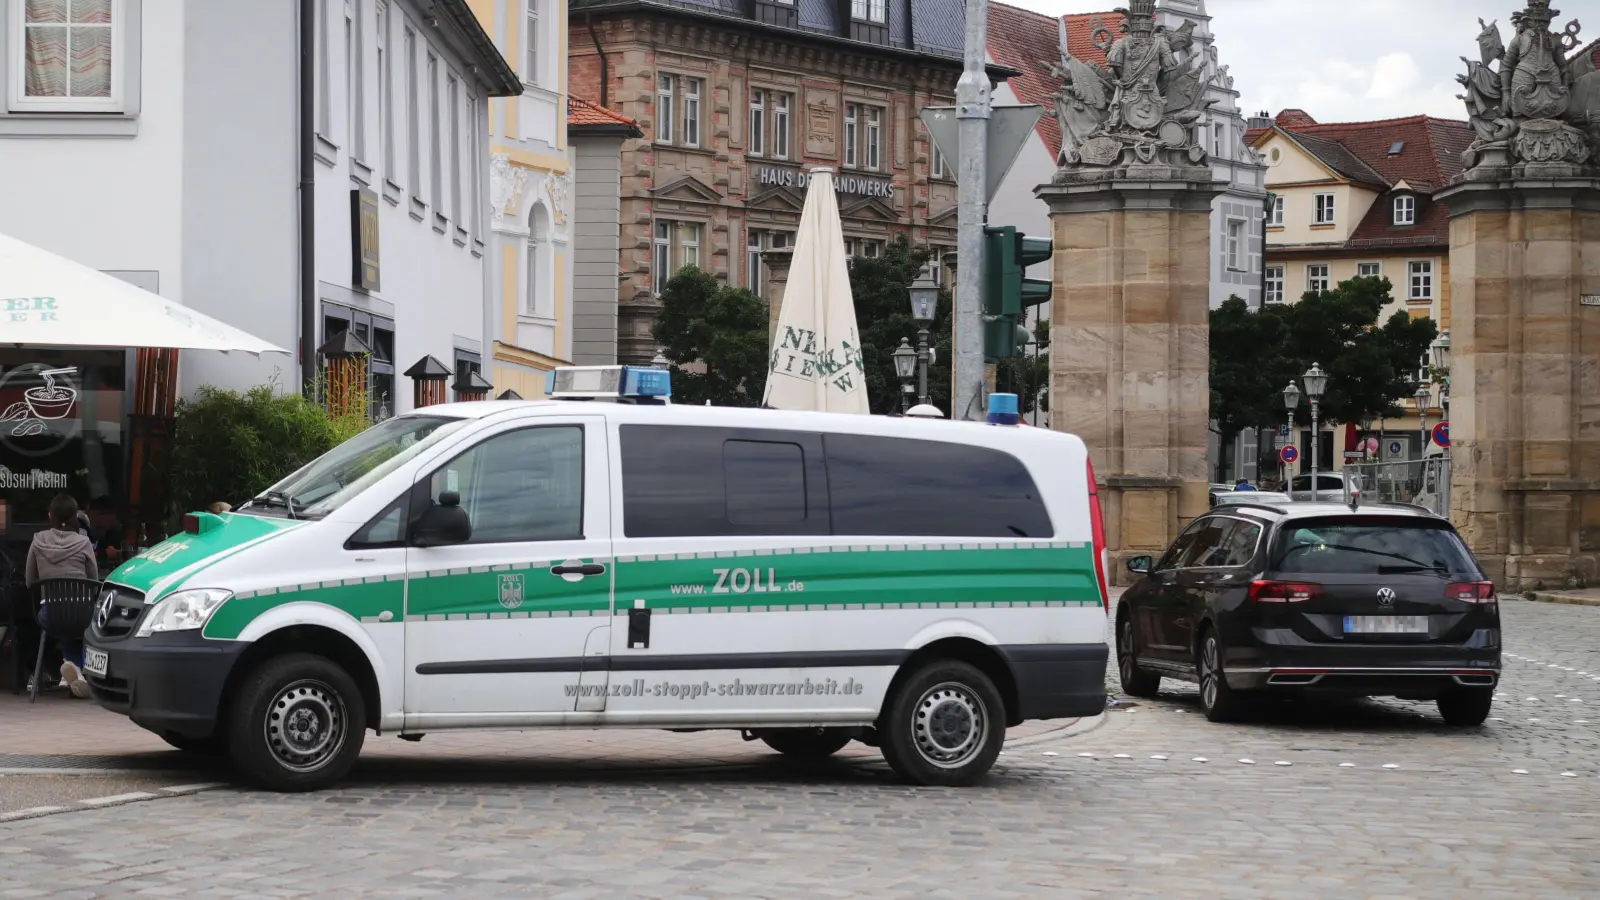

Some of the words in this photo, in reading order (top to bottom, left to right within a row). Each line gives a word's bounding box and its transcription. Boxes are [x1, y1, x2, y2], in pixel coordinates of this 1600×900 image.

[761, 167, 792, 187] HAUS
[834, 177, 894, 198] ANDWERKS
[0, 473, 29, 489] SUSHI
[37, 473, 67, 489] ASIAN
[564, 677, 863, 700] www.zoll-stoppt-schwarzarbeit.de
